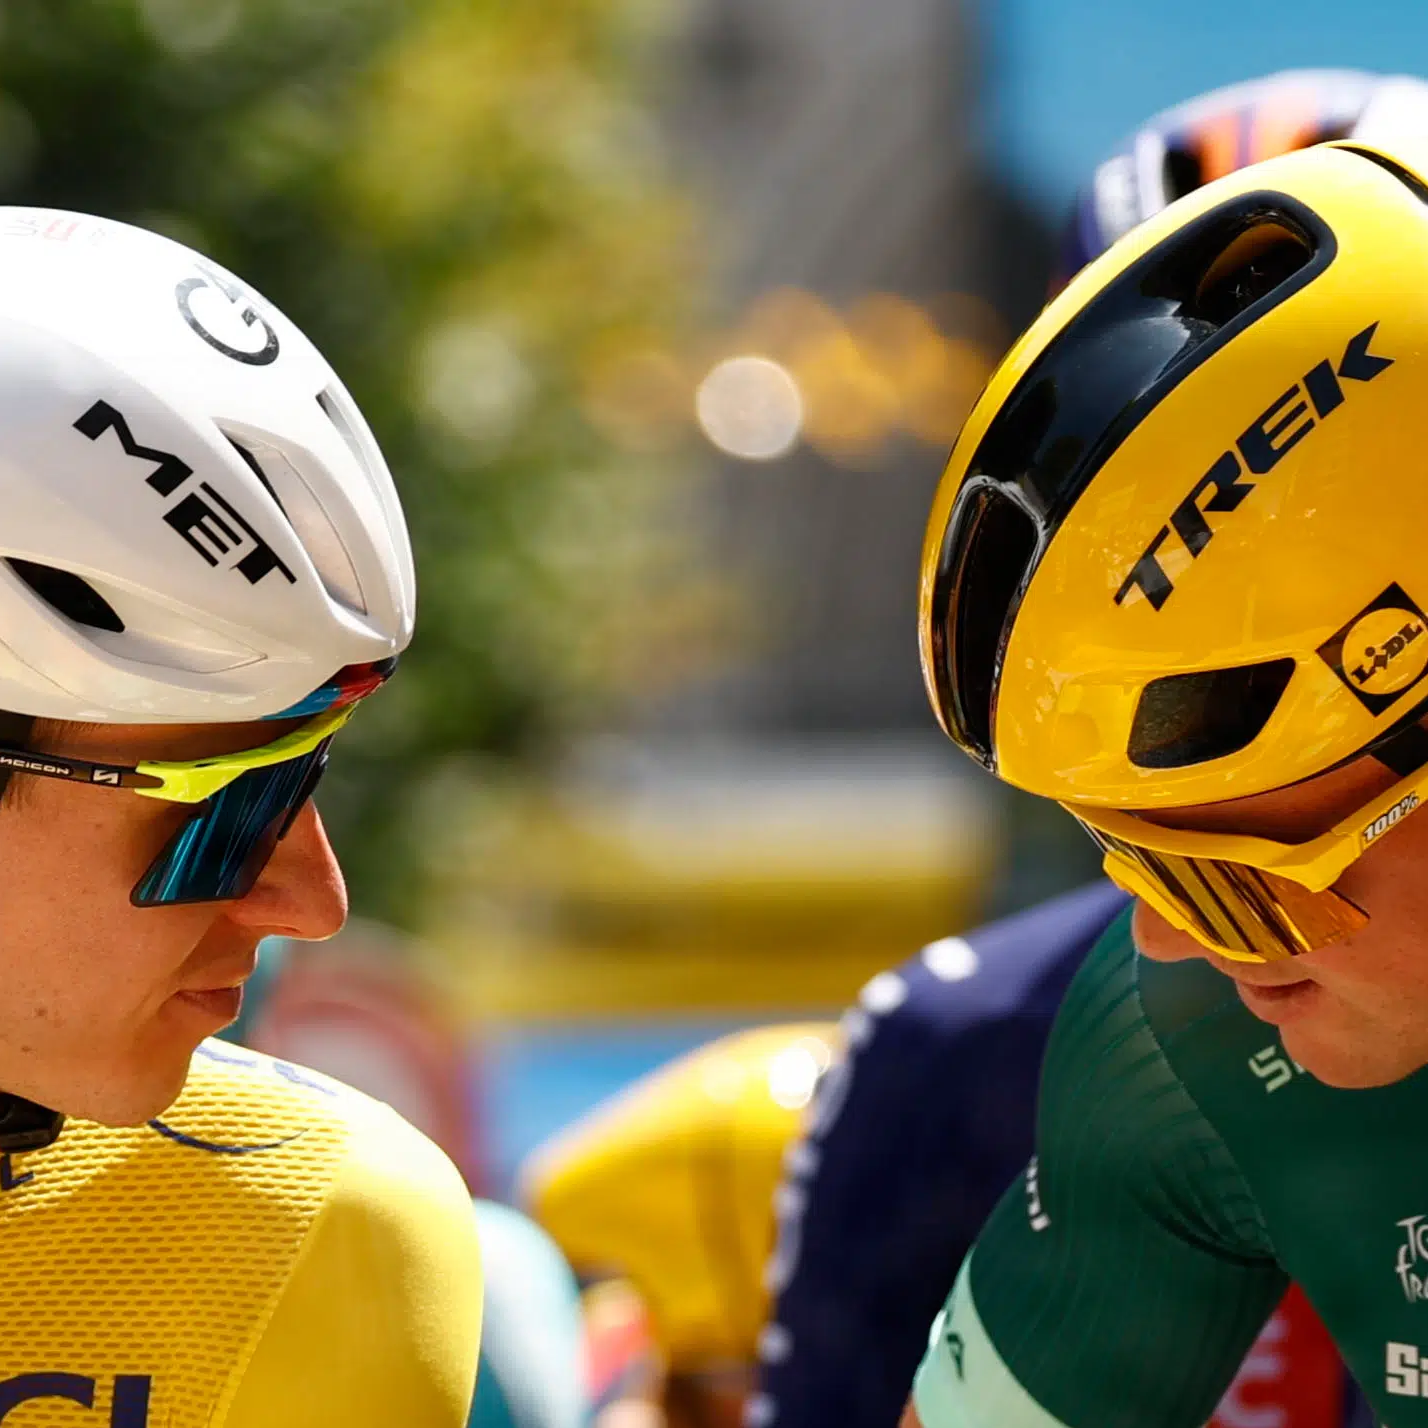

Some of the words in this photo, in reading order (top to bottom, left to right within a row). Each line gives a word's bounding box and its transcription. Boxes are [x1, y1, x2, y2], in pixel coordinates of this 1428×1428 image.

[71, 398, 297, 586] MET
[1113, 320, 1396, 612] TREK
[1363, 792, 1420, 843] 100%
